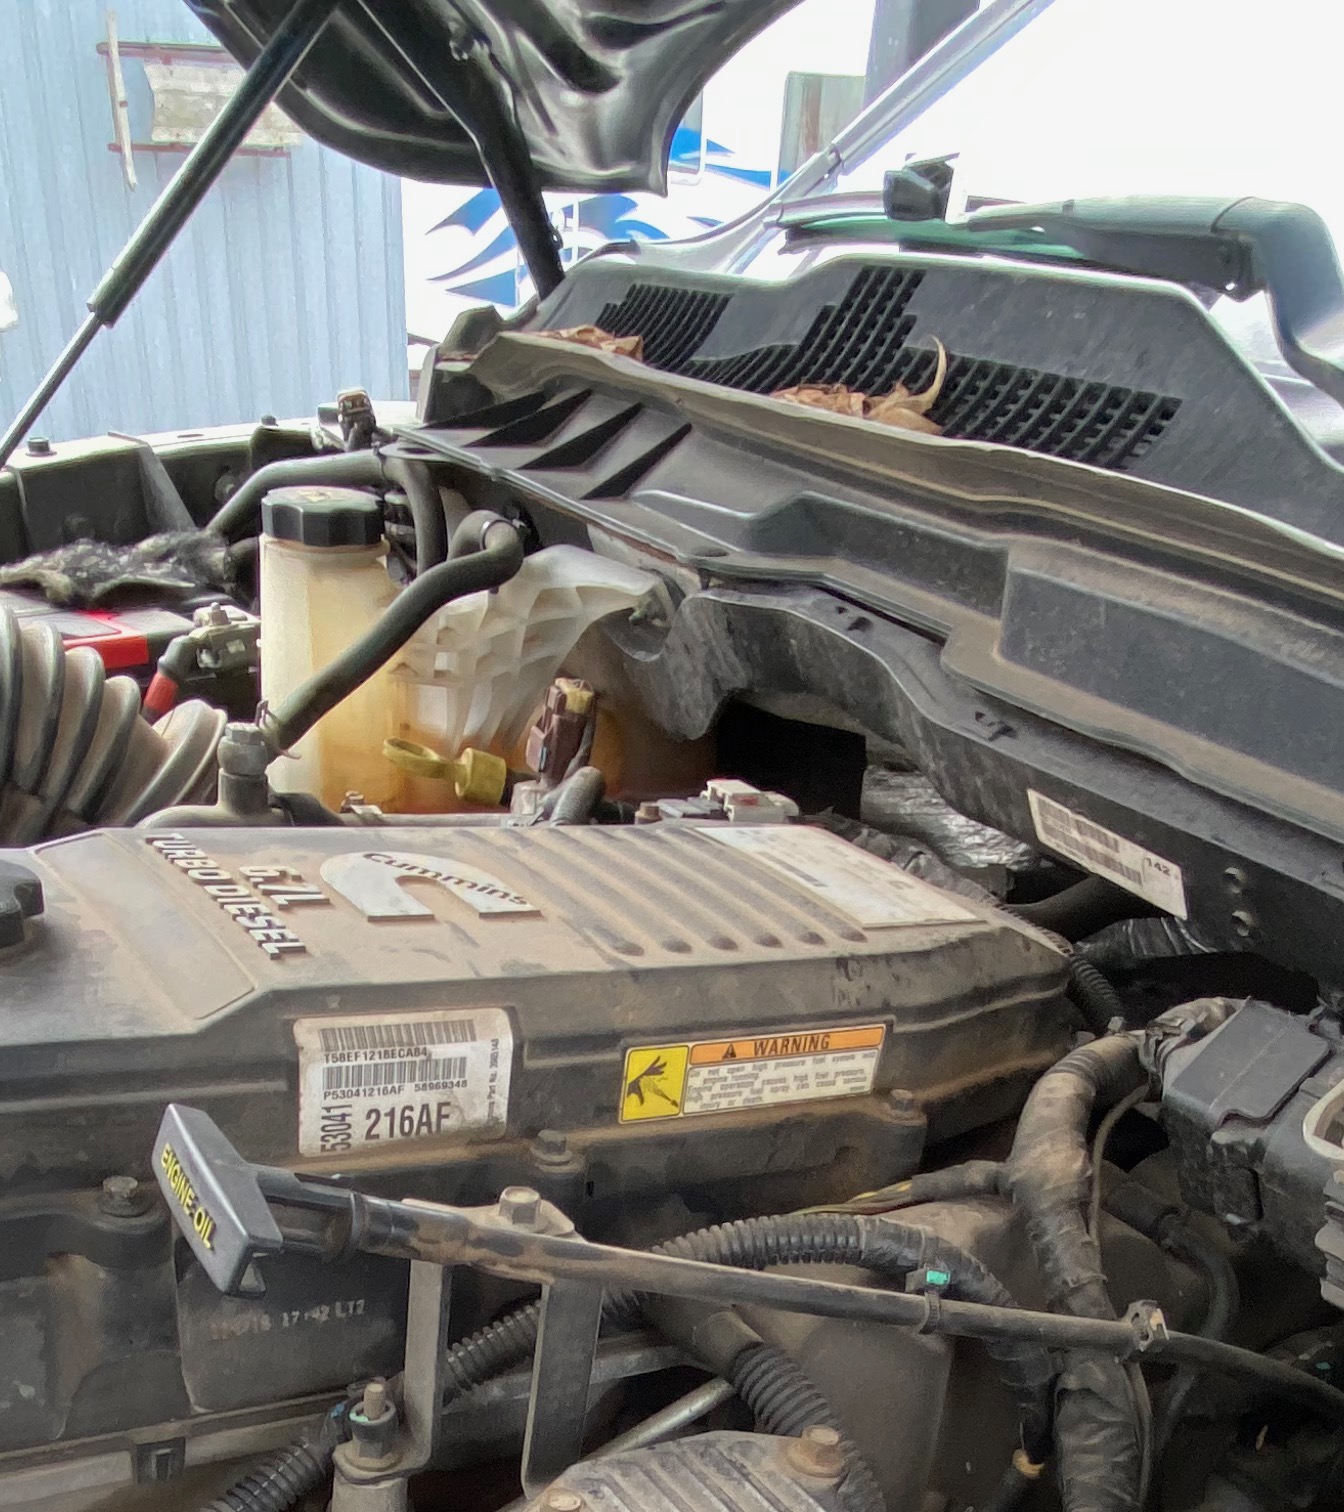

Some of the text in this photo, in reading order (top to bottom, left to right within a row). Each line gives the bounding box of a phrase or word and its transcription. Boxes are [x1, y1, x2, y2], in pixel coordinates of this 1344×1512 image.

[144, 832, 307, 960] TURBO DIESEL
[239, 864, 329, 910] 6.7L
[362, 852, 528, 906] Cummins
[752, 1034, 831, 1057] WARNING
[364, 1100, 452, 1142] 216AF
[160, 1142, 214, 1249] ENGINE OIL
